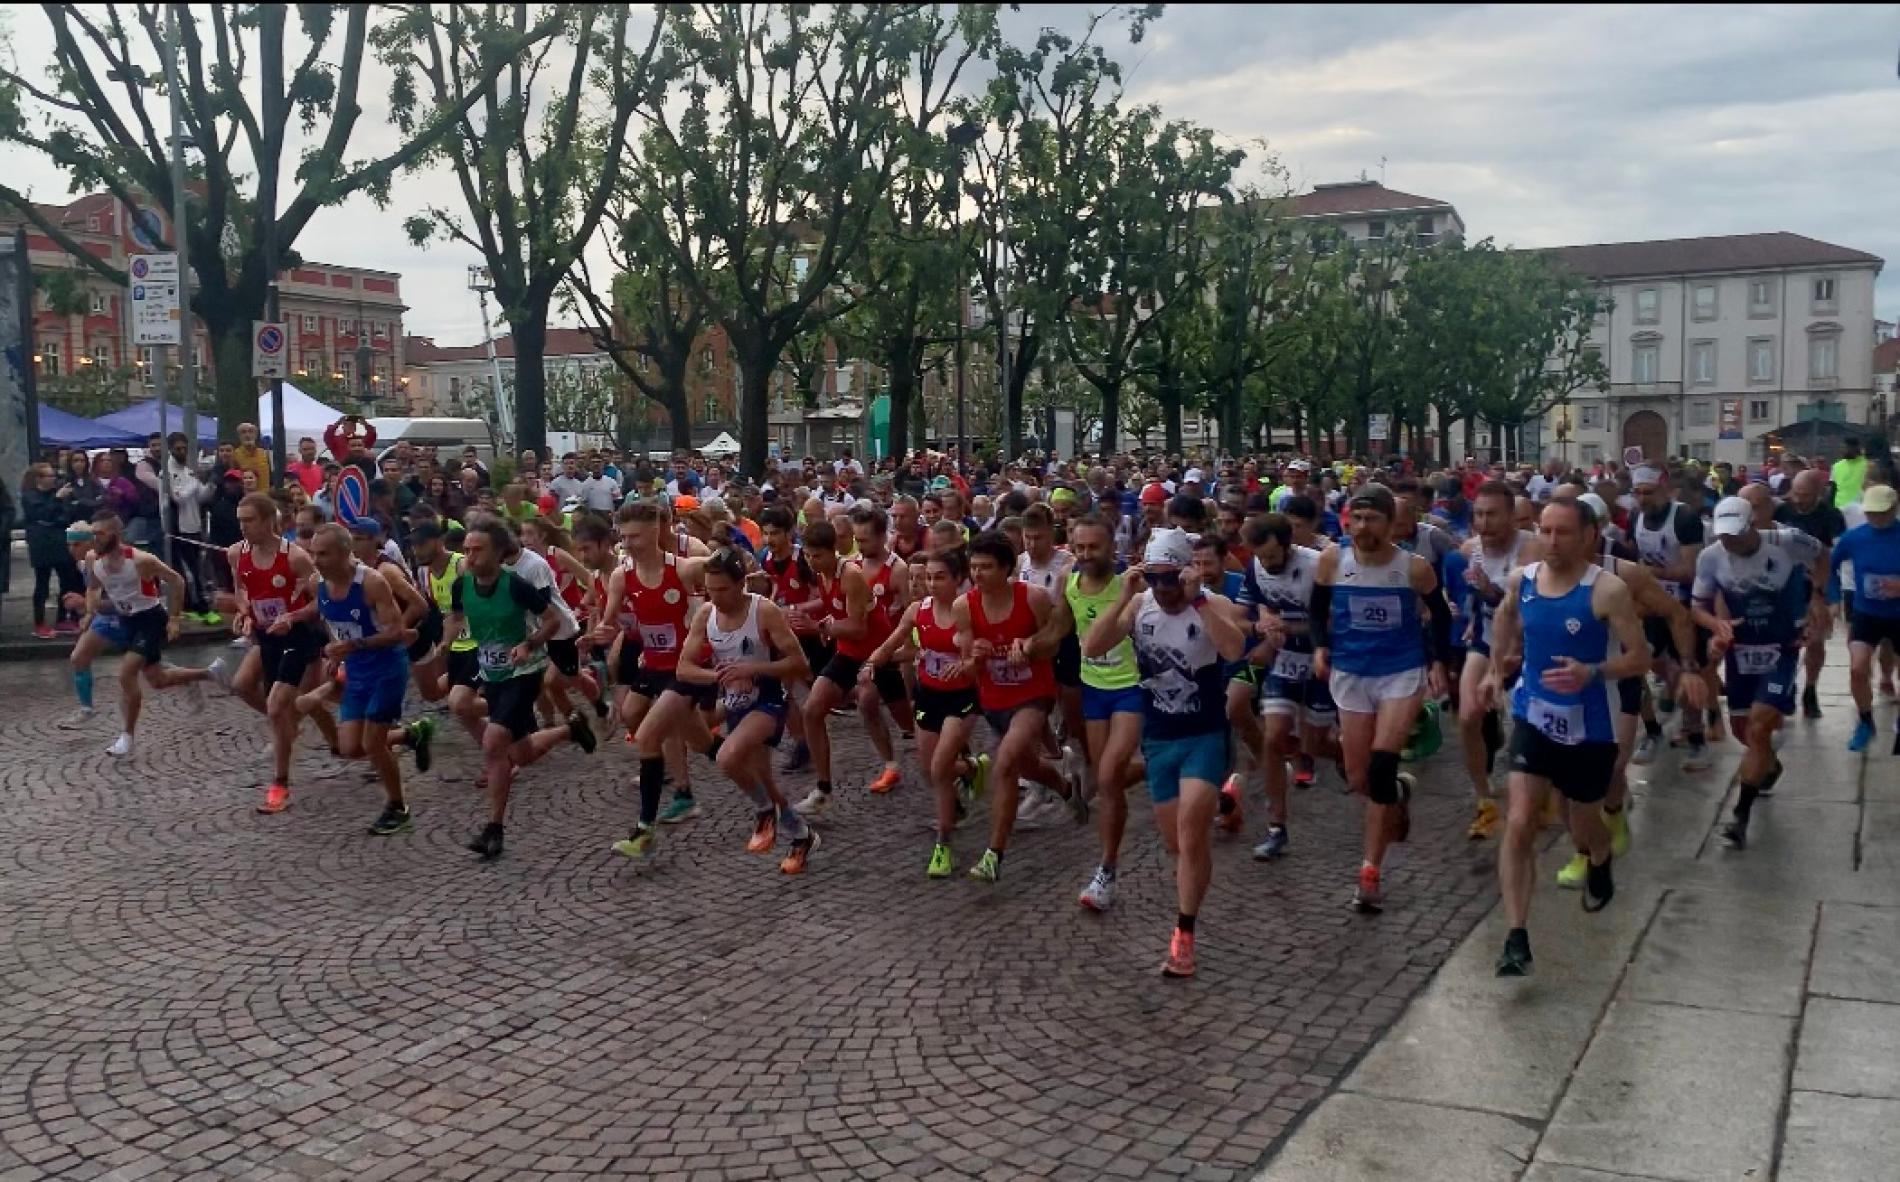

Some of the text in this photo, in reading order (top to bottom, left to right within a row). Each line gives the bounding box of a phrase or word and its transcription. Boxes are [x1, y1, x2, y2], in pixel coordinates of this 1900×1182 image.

[1364, 607, 1388, 622] 29
[648, 632, 668, 647] 16
[1543, 711, 1569, 735] 28
